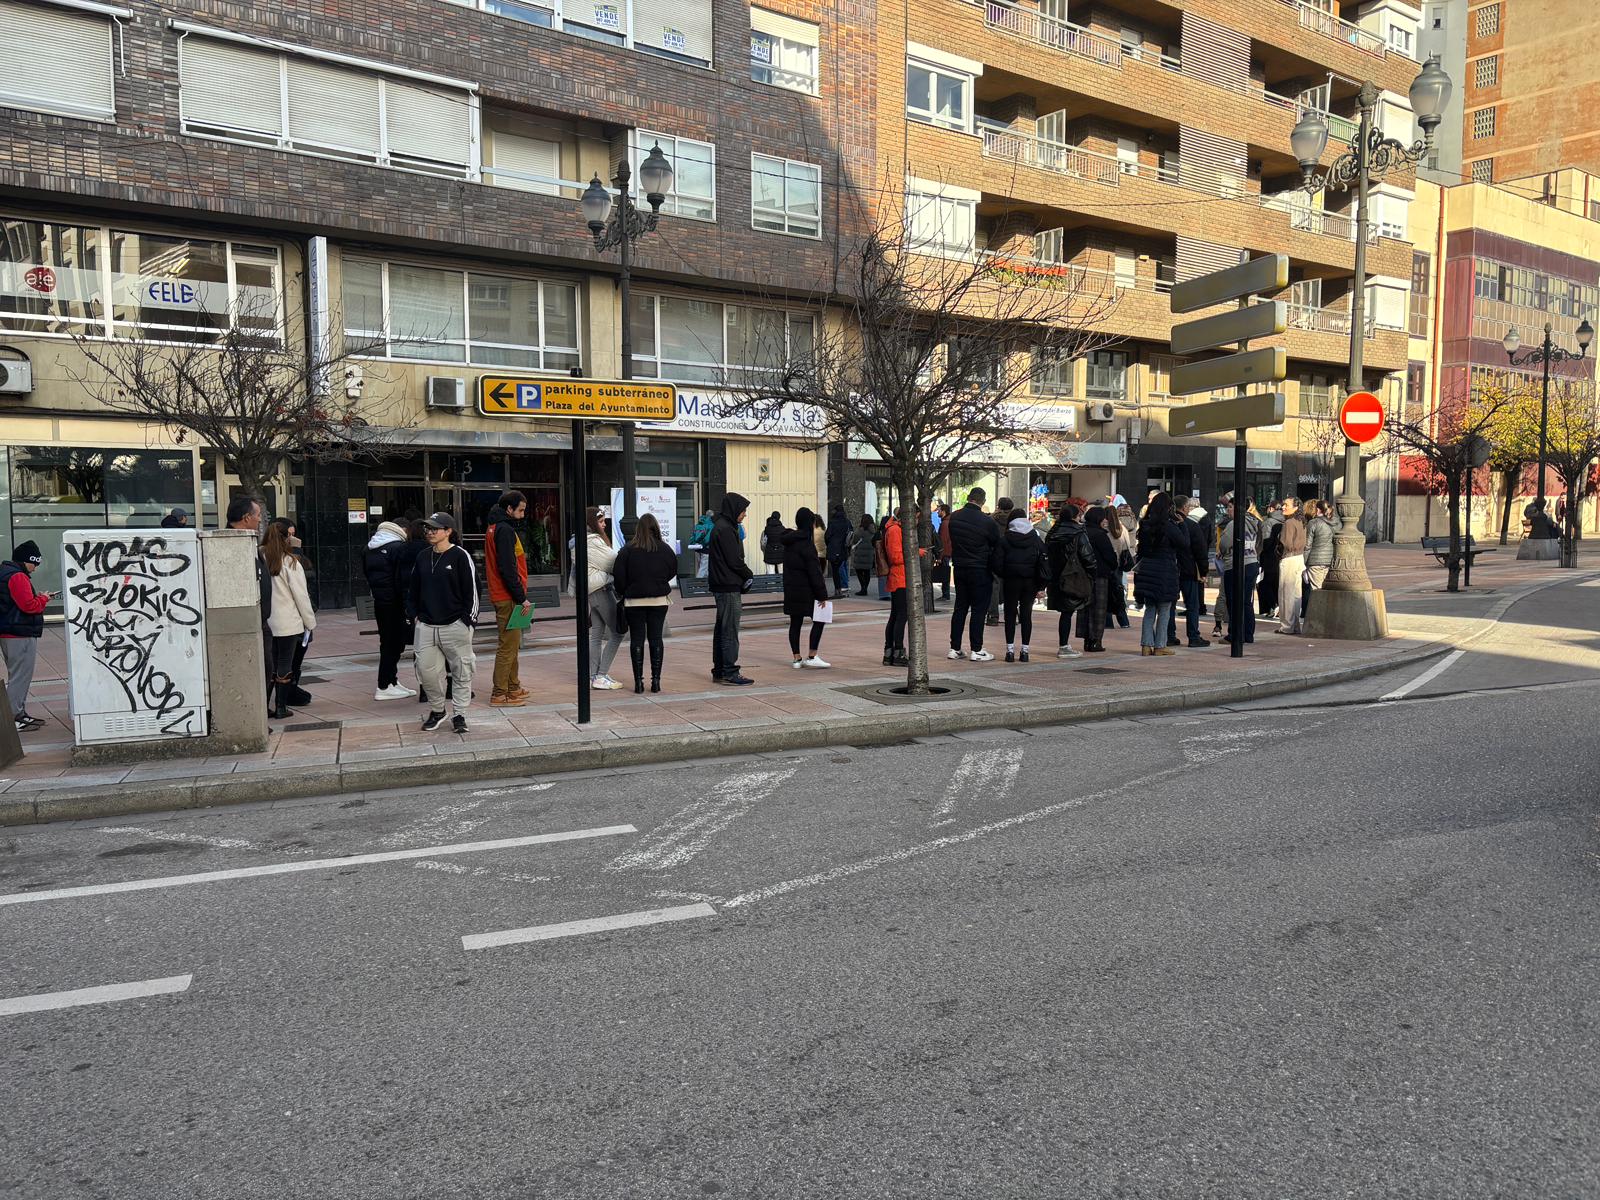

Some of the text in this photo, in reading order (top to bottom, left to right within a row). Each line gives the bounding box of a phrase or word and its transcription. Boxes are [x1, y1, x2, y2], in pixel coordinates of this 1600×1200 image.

[594, 10, 619, 21] VENDE
[663, 33, 685, 44] VENDE
[521, 386, 538, 407] P
[545, 385, 670, 399] parking subterráneo
[545, 401, 670, 414] Plaza del Ayuntamiento
[678, 419, 749, 430] CONSTRUCCIONES
[463, 460, 473, 475] 3
